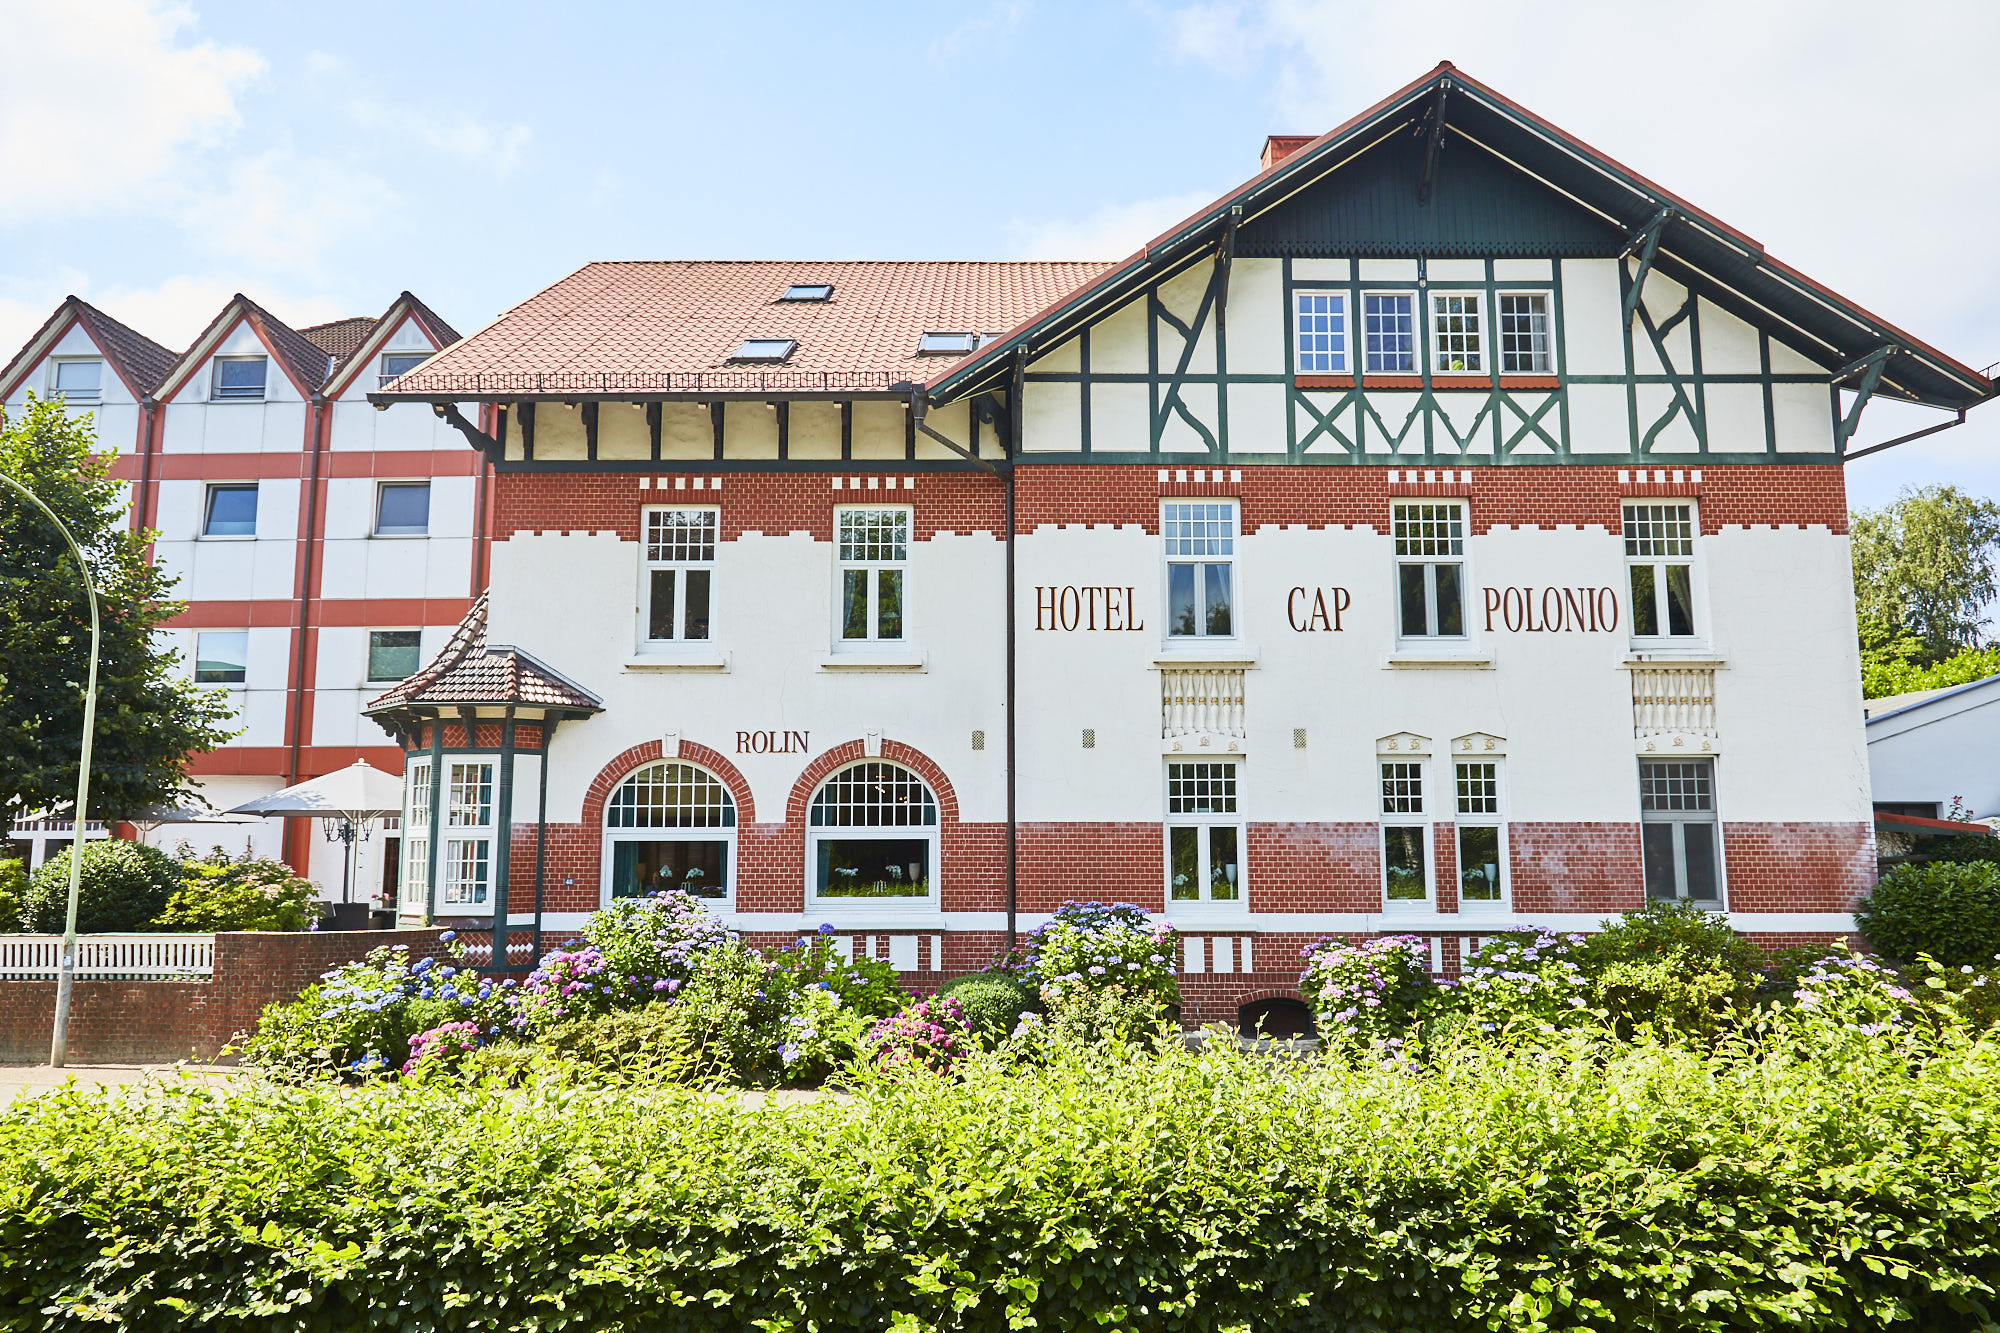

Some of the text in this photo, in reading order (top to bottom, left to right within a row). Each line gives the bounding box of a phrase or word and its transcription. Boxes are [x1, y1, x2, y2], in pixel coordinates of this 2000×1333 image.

[1035, 585, 1619, 633] HOTEL CAP POLONIO
[735, 730, 810, 754] ROLIN
